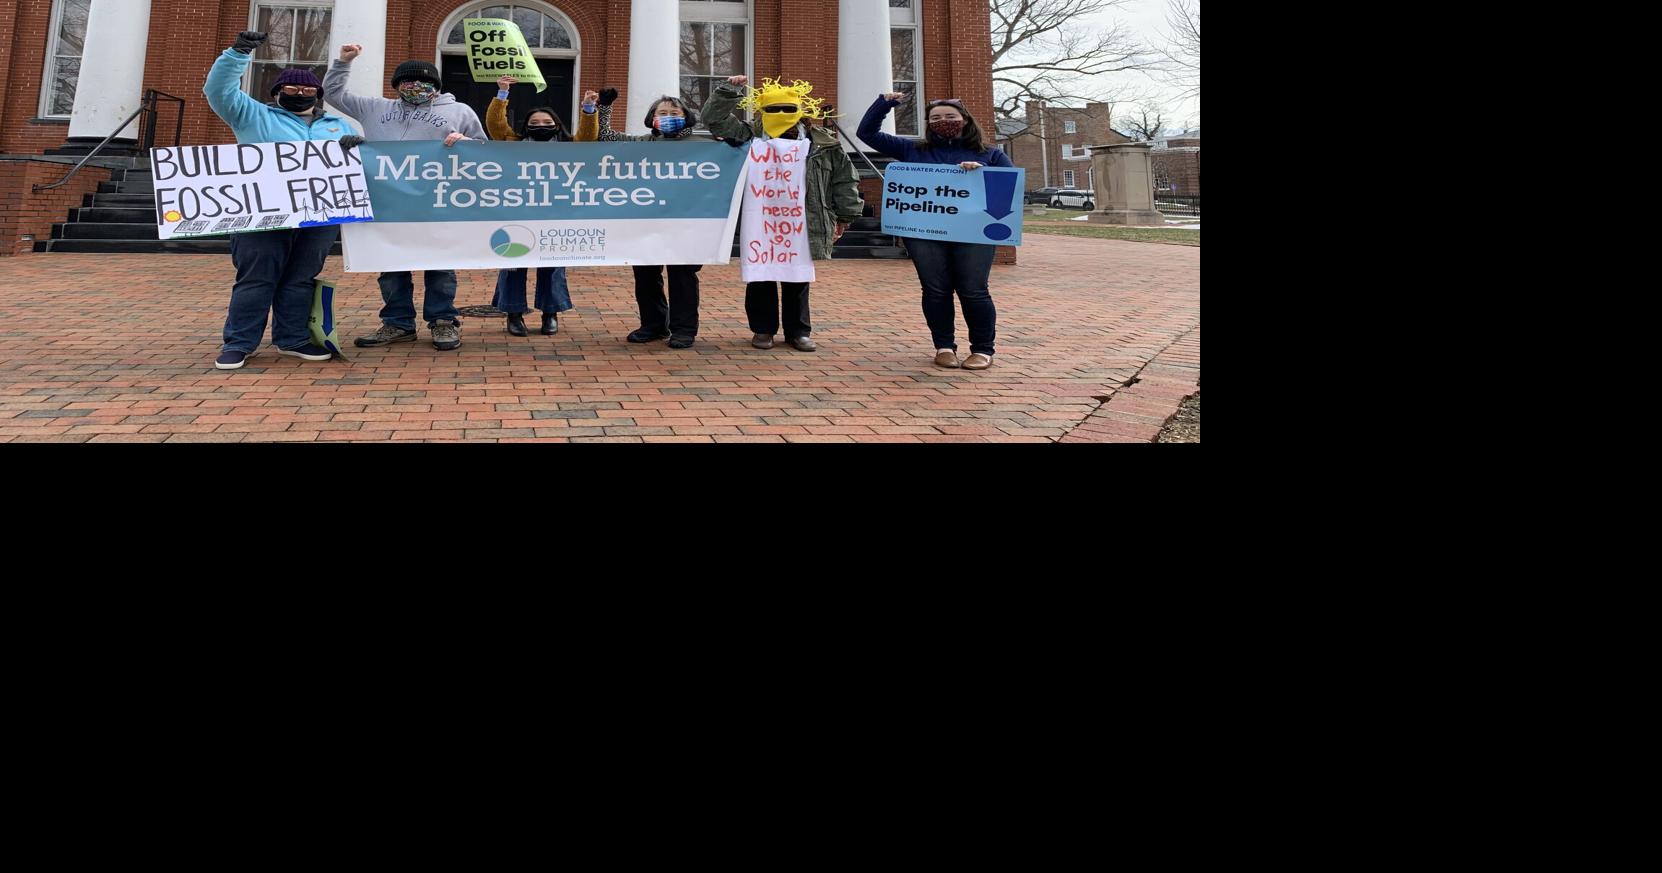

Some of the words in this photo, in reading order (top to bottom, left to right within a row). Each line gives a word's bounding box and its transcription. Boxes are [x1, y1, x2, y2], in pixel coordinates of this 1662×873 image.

[469, 30, 506, 42] Off
[471, 44, 527, 56] Fossil
[472, 57, 526, 70] Fuels
[413, 110, 447, 128] BANKS
[152, 144, 264, 181] BUILD
[274, 140, 362, 173] BACK
[750, 145, 800, 163] What
[374, 154, 503, 181] Make
[517, 161, 585, 187] my
[597, 154, 721, 180] future
[763, 167, 792, 182] the
[432, 180, 667, 208] fossil-free.
[887, 182, 927, 198] Stop
[934, 185, 970, 198] the
[156, 182, 280, 226] FOSSIL
[286, 173, 369, 213] FREE
[885, 198, 959, 214] Pipeline
[762, 202, 802, 217] needs
[540, 229, 606, 237] LOUDOUN
[764, 220, 803, 235] NOW
[540, 238, 606, 246] CLIMATE
[748, 240, 798, 264] Solar
